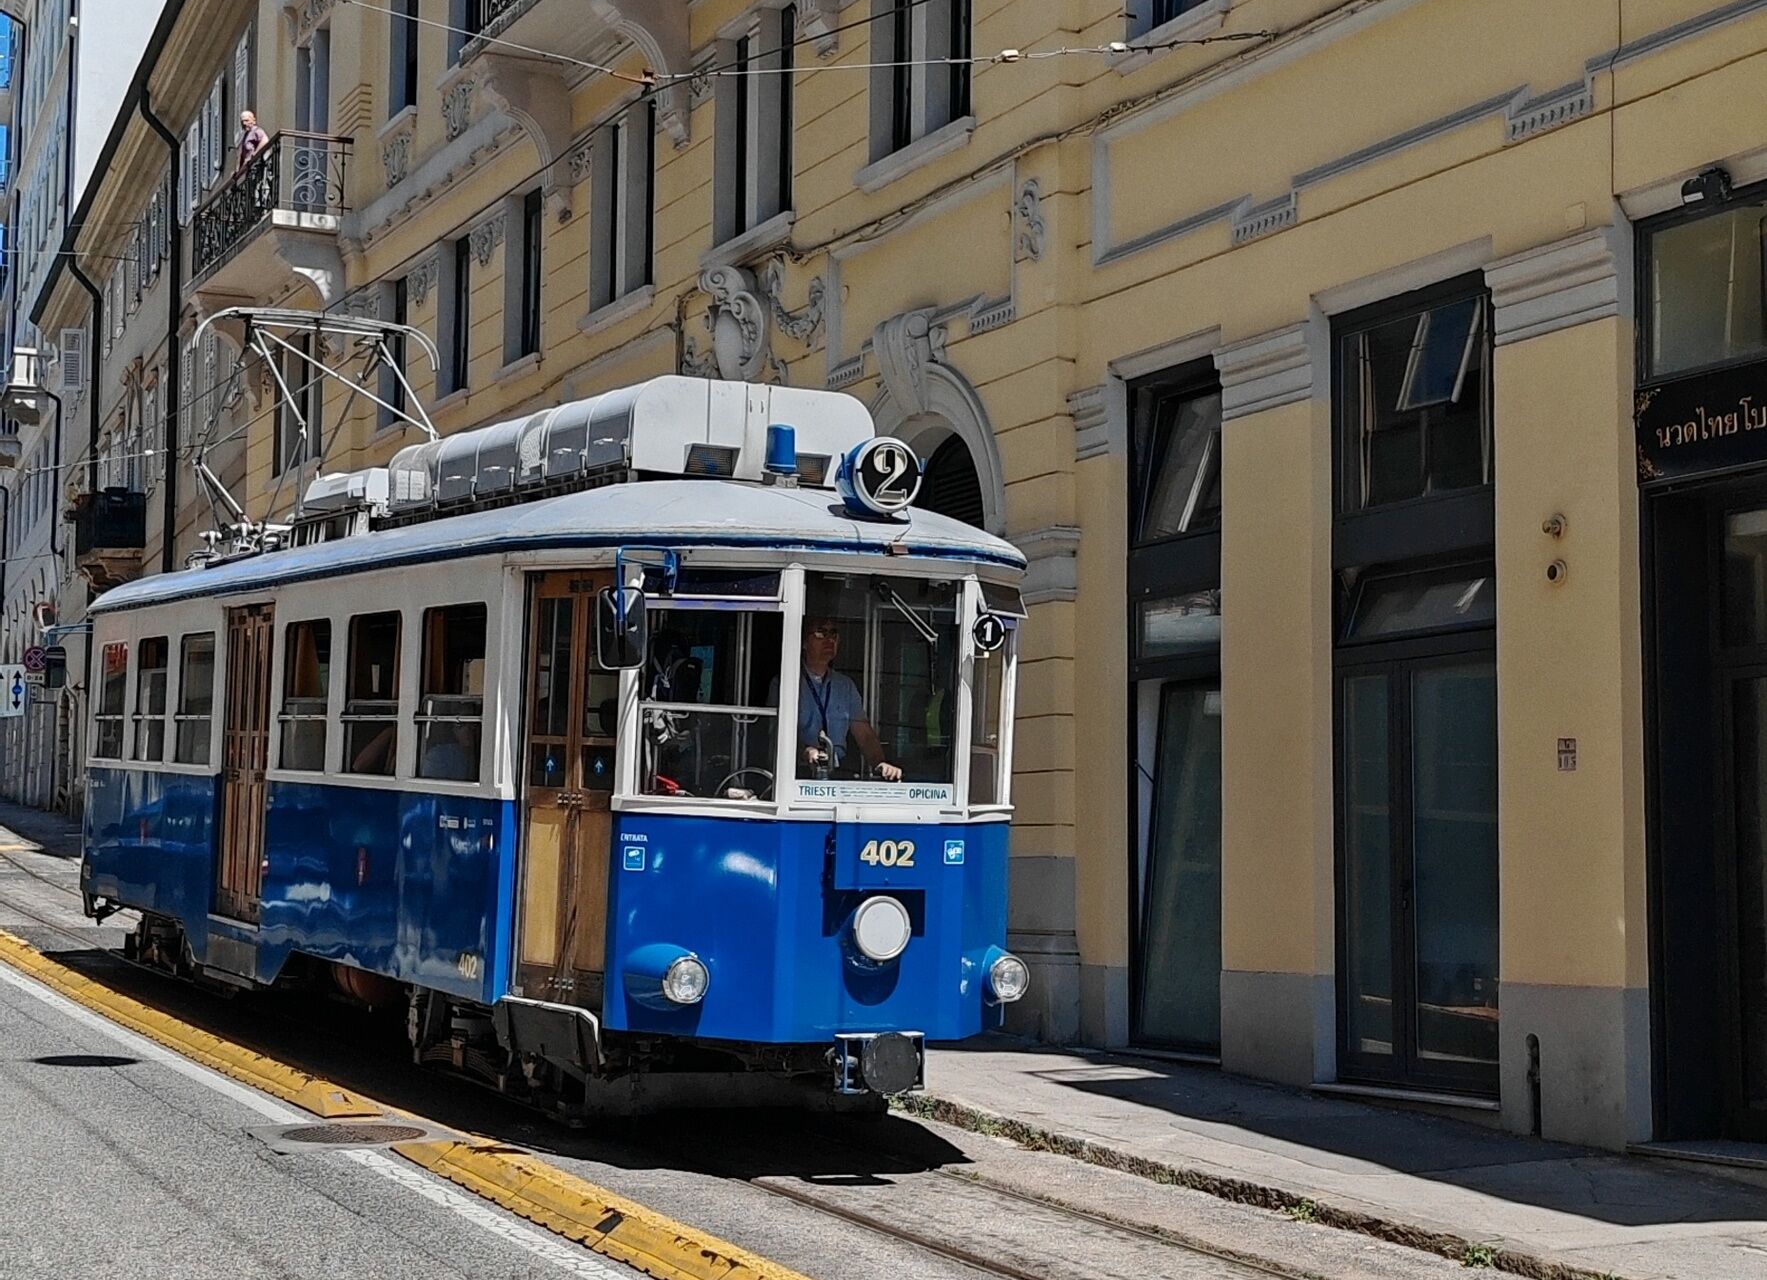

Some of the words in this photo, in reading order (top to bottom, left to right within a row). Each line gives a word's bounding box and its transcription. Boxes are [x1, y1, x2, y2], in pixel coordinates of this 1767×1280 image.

[873, 444, 908, 503] 2
[983, 621, 993, 642] 1
[799, 785, 837, 797] TRIESTE
[909, 788, 948, 800] OPICINA
[860, 840, 915, 867] 402
[458, 953, 477, 979] 402
